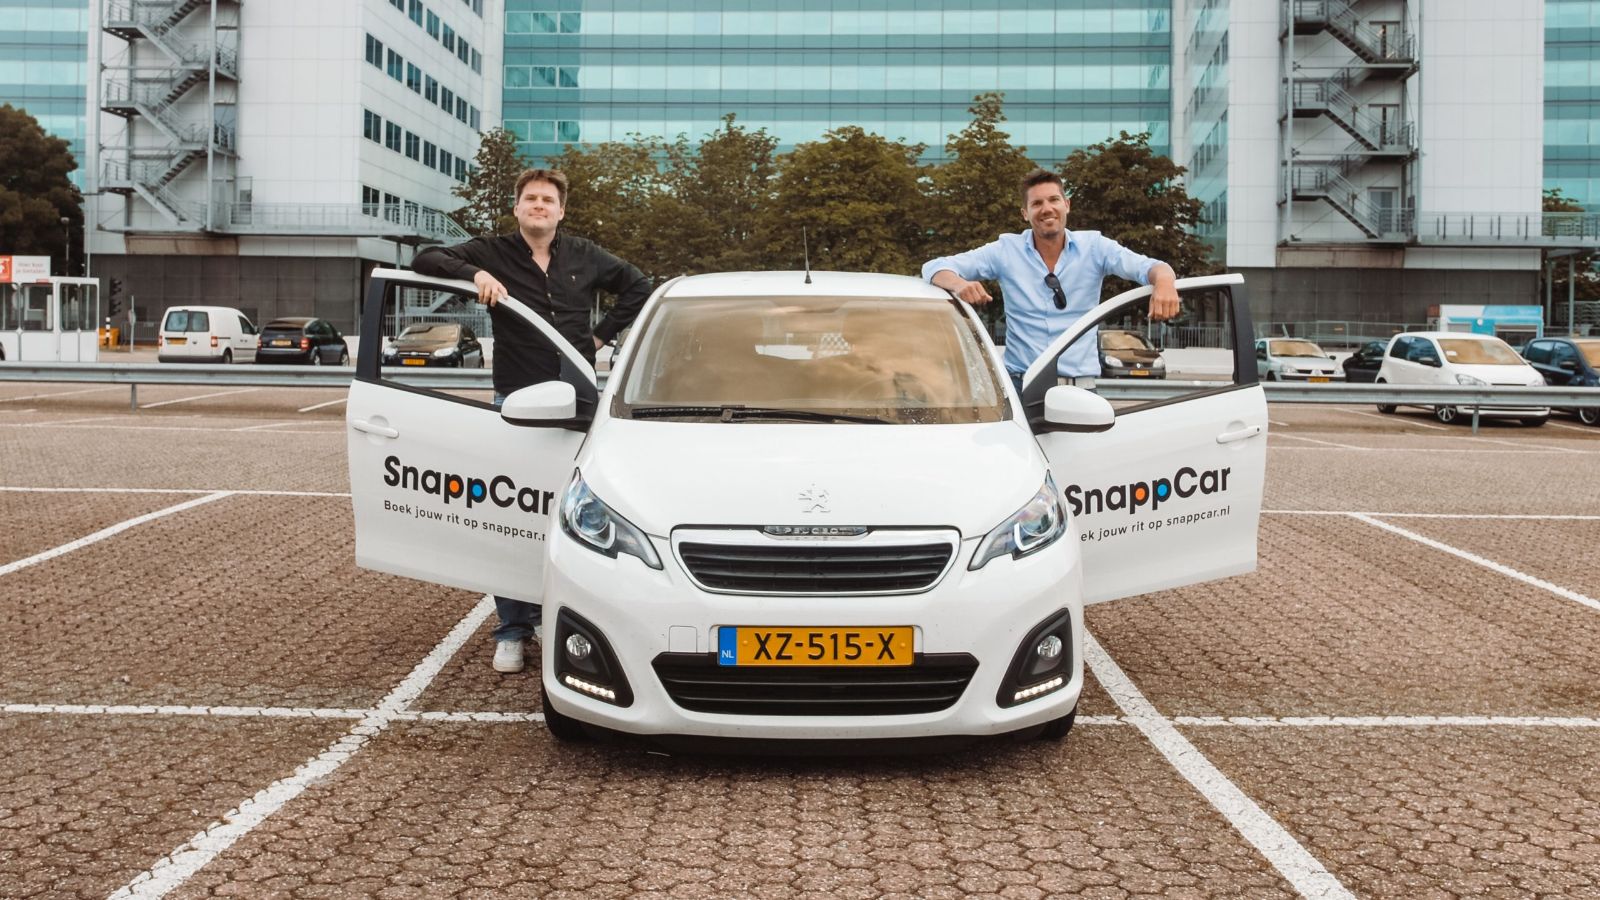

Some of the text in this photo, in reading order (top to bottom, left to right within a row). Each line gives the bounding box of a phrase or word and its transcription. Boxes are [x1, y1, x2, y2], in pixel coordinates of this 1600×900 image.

[384, 455, 554, 515] SnappCar
[1064, 466, 1231, 517] SnappCar
[384, 500, 546, 541] Boek jouw rit op snappcar.
[1080, 505, 1231, 542] ek jouw rit op snappcar.nl
[721, 650, 735, 659] NL
[753, 632, 896, 661] XZ-515-X
